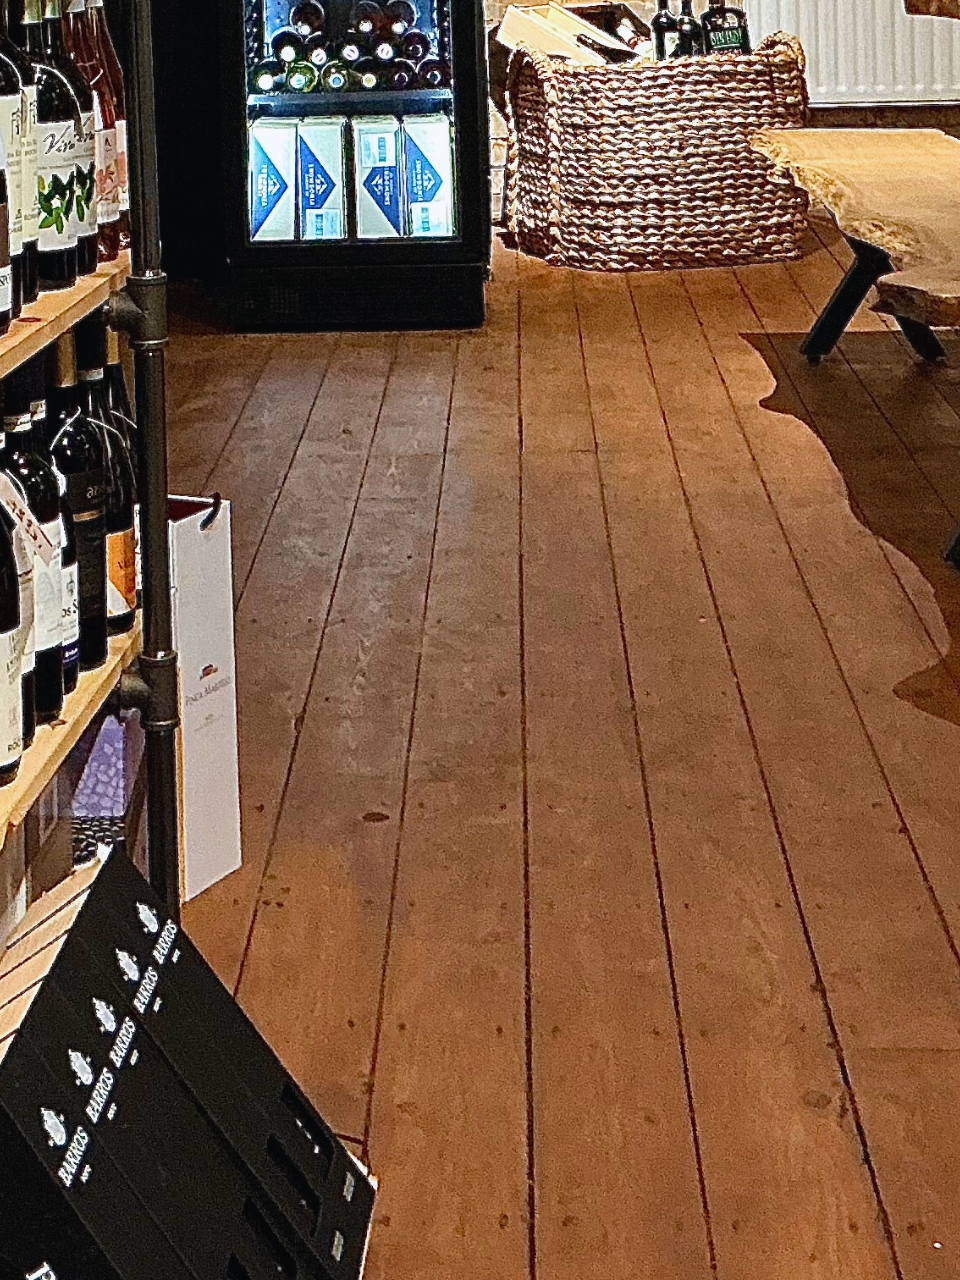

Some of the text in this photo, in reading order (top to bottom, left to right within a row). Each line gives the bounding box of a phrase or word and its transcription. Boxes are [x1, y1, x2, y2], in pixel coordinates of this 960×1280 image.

[152, 919, 177, 965] BARROS
[133, 966, 158, 1014] BARROS
[109, 1016, 136, 1069] BARROS
[85, 1067, 114, 1124] BARROS
[57, 1125, 89, 1188] BARROS
